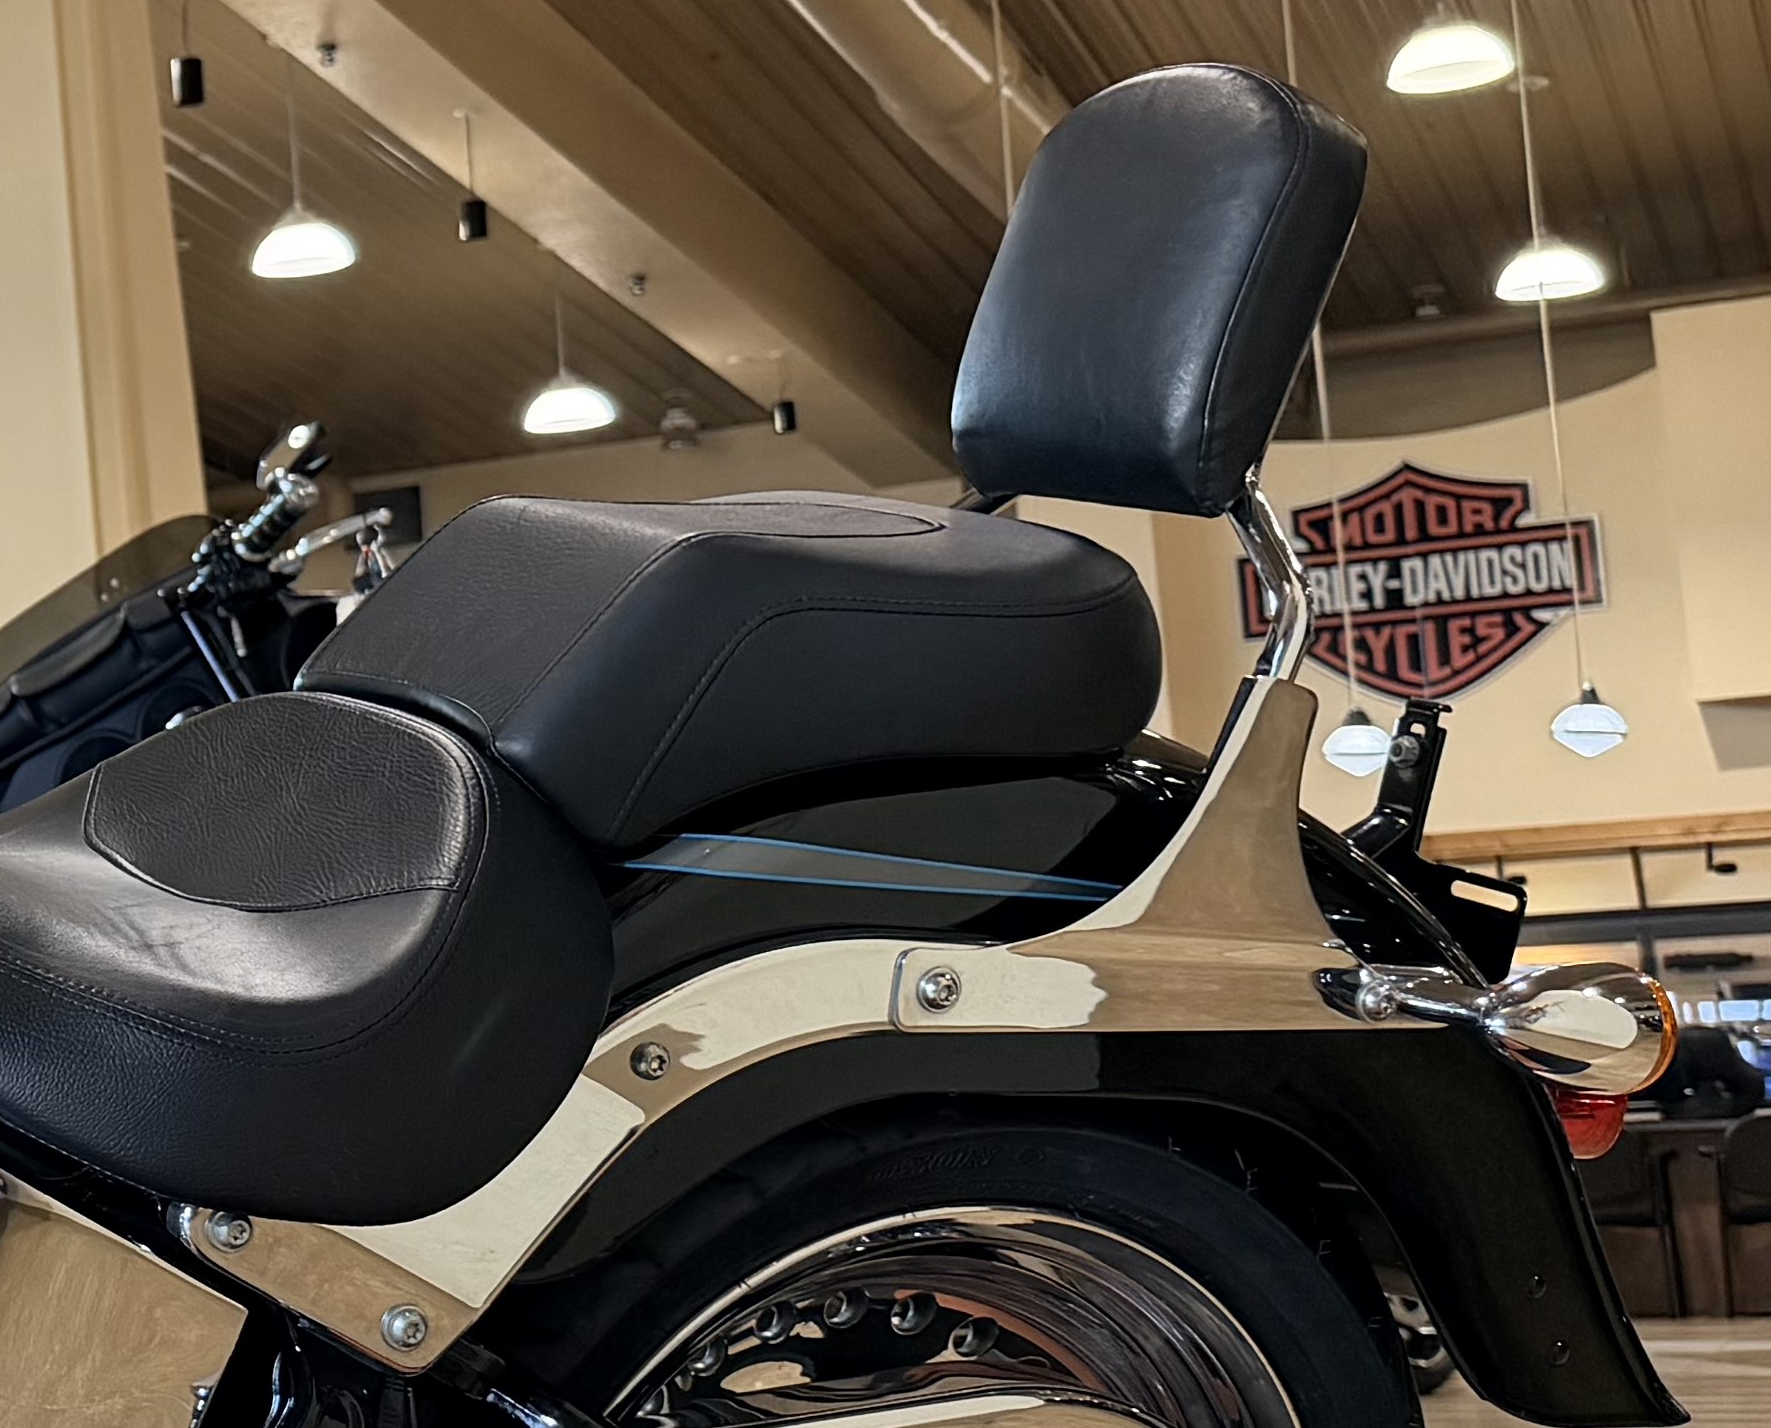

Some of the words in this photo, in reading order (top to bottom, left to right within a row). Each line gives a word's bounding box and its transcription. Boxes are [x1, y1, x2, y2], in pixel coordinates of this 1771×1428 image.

[1329, 487, 1499, 545] MOTOR
[1265, 539, 1573, 617] RLEY-DAVIDSON
[1338, 612, 1508, 684] CYCLES
